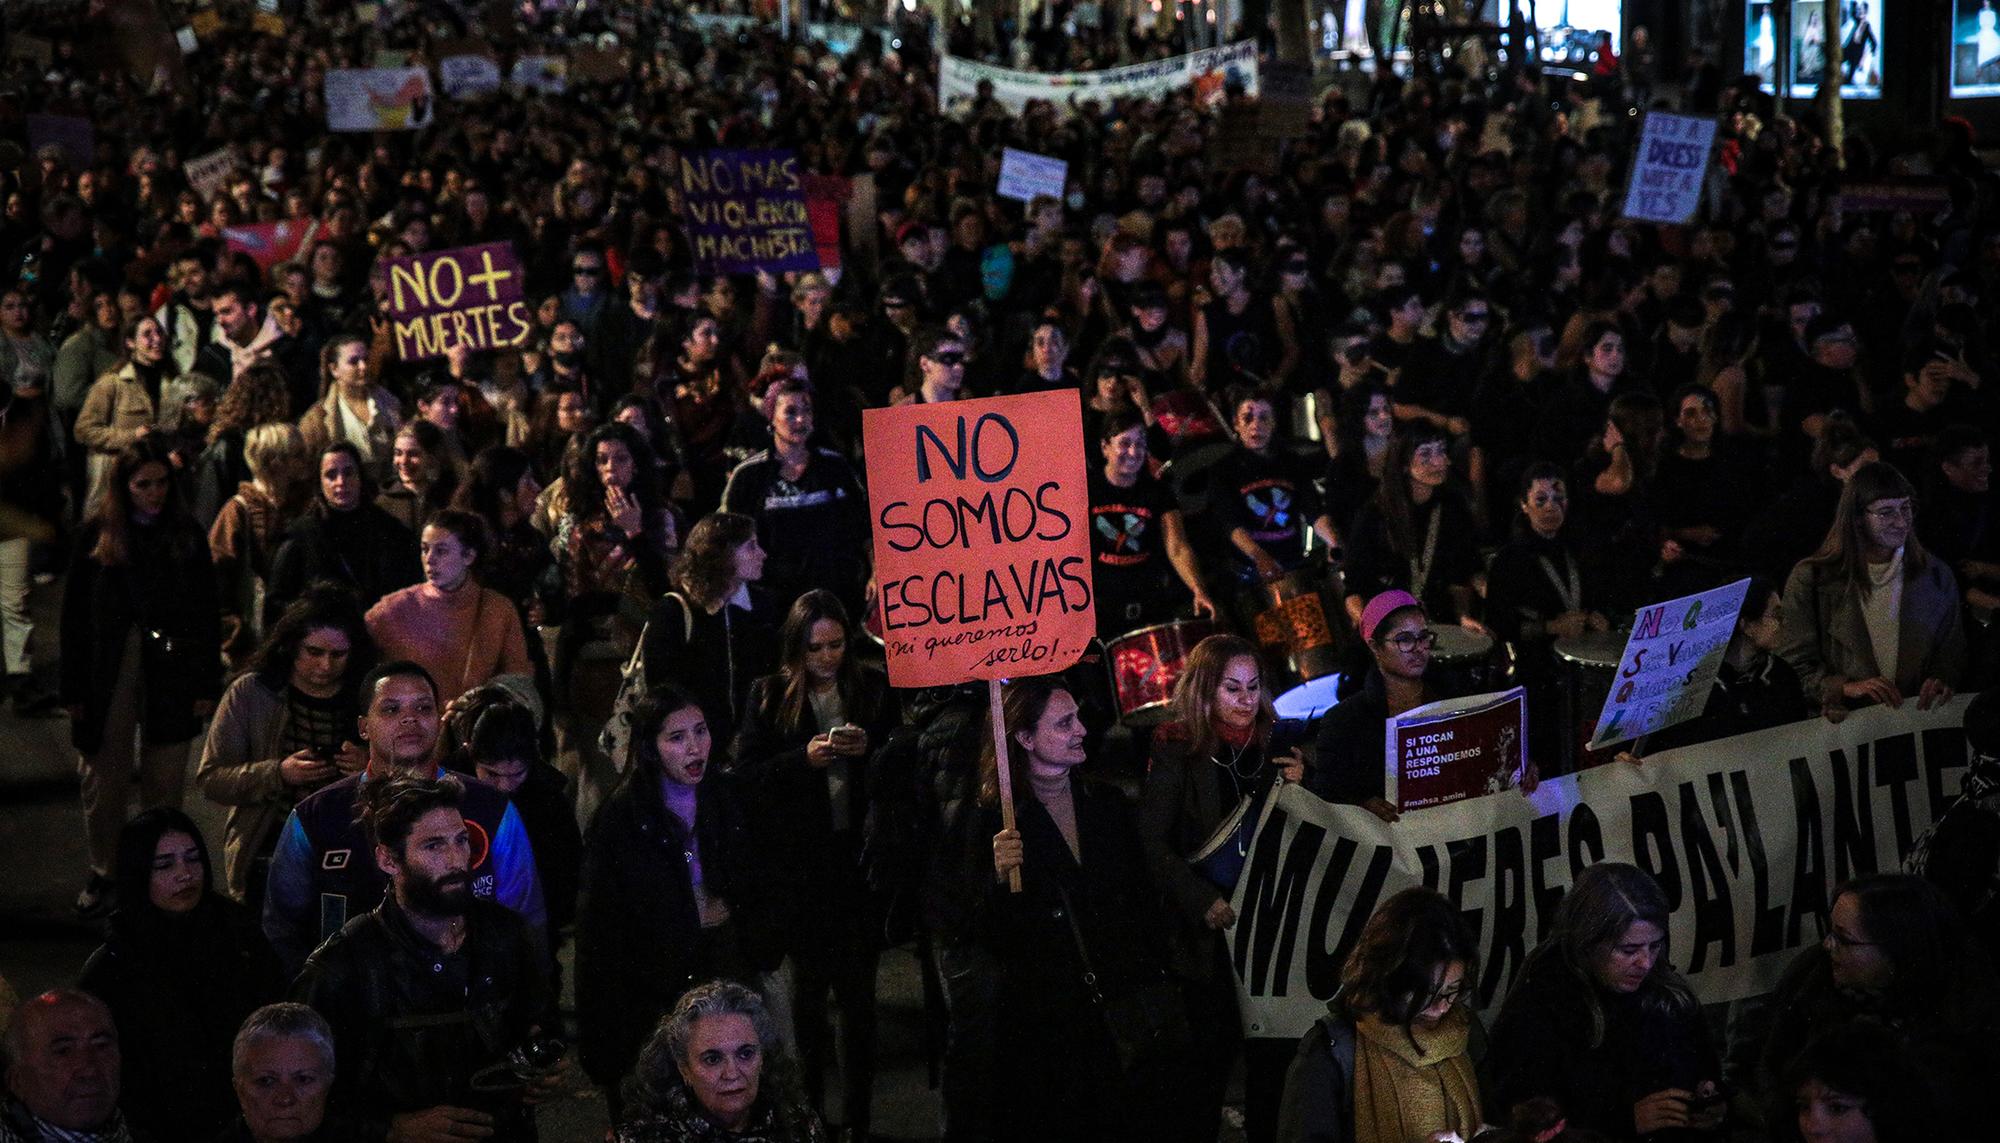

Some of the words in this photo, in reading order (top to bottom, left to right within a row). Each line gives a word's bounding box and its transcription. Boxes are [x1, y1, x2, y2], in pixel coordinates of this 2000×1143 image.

[1647, 138, 1701, 168] DRESS
[681, 155, 735, 195] NO
[1639, 190, 1676, 216] YES
[394, 301, 530, 361] MUERTES
[916, 413, 1019, 483] NO
[880, 482, 1072, 552] SOMOS
[883, 557, 1091, 631] ESCLAVAS
[925, 620, 1037, 660] queremos
[1405, 738, 1416, 748] SI
[1419, 731, 1454, 746] TOCAN
[1405, 750, 1414, 759] A
[1416, 745, 1439, 757] UNA
[1405, 747, 1481, 769] RESPONDEMOS
[1405, 766, 1441, 780] TODAS
